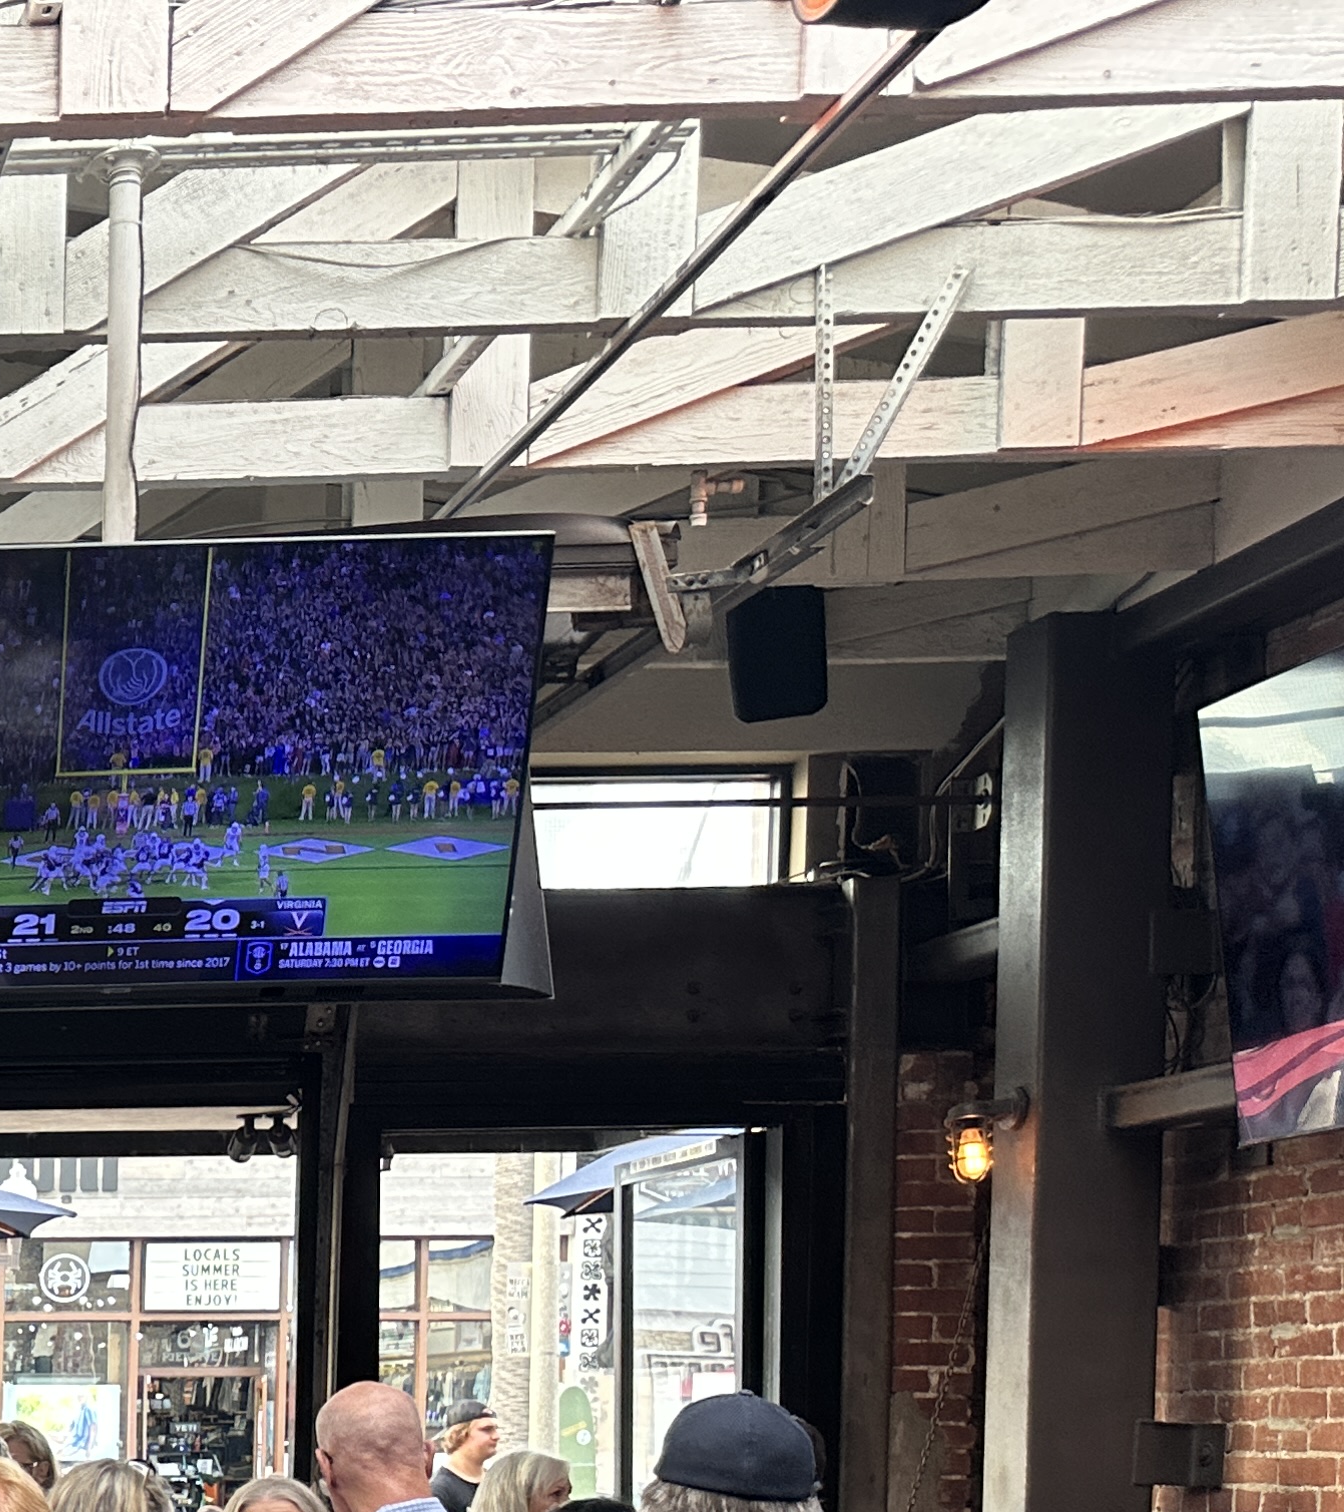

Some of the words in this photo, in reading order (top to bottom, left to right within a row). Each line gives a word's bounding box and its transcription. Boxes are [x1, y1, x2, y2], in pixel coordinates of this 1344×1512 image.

[76, 708, 181, 736] Allstate
[101, 900, 147, 914] ESPN
[276, 900, 323, 910] VIRGINIA
[12, 913, 56, 936] 21
[184, 909, 240, 931] 20
[153, 922, 172, 932] 40
[126, 946, 140, 956] ET
[289, 941, 352, 957] ALABAMA
[377, 939, 433, 955] GEORGIA
[13, 962, 47, 975] games
[49, 961, 62, 974] by
[63, 961, 82, 972] 10+
[84, 960, 116, 974] points
[118, 959, 133, 971] for
[135, 959, 150, 970] 1st
[152, 958, 174, 969] time
[176, 957, 203, 969] since
[204, 956, 231, 968] 2017
[278, 958, 323, 969] SATURDAY
[345, 957, 360, 968] PM
[184, 1248, 240, 1261] LOCALS
[182, 1264, 240, 1277] SUMMER
[185, 1279, 198, 1291] IS
[204, 1279, 237, 1291] HERE
[186, 1294, 237, 1306] ENJOY!
[175, 1424, 197, 1432] YETI
